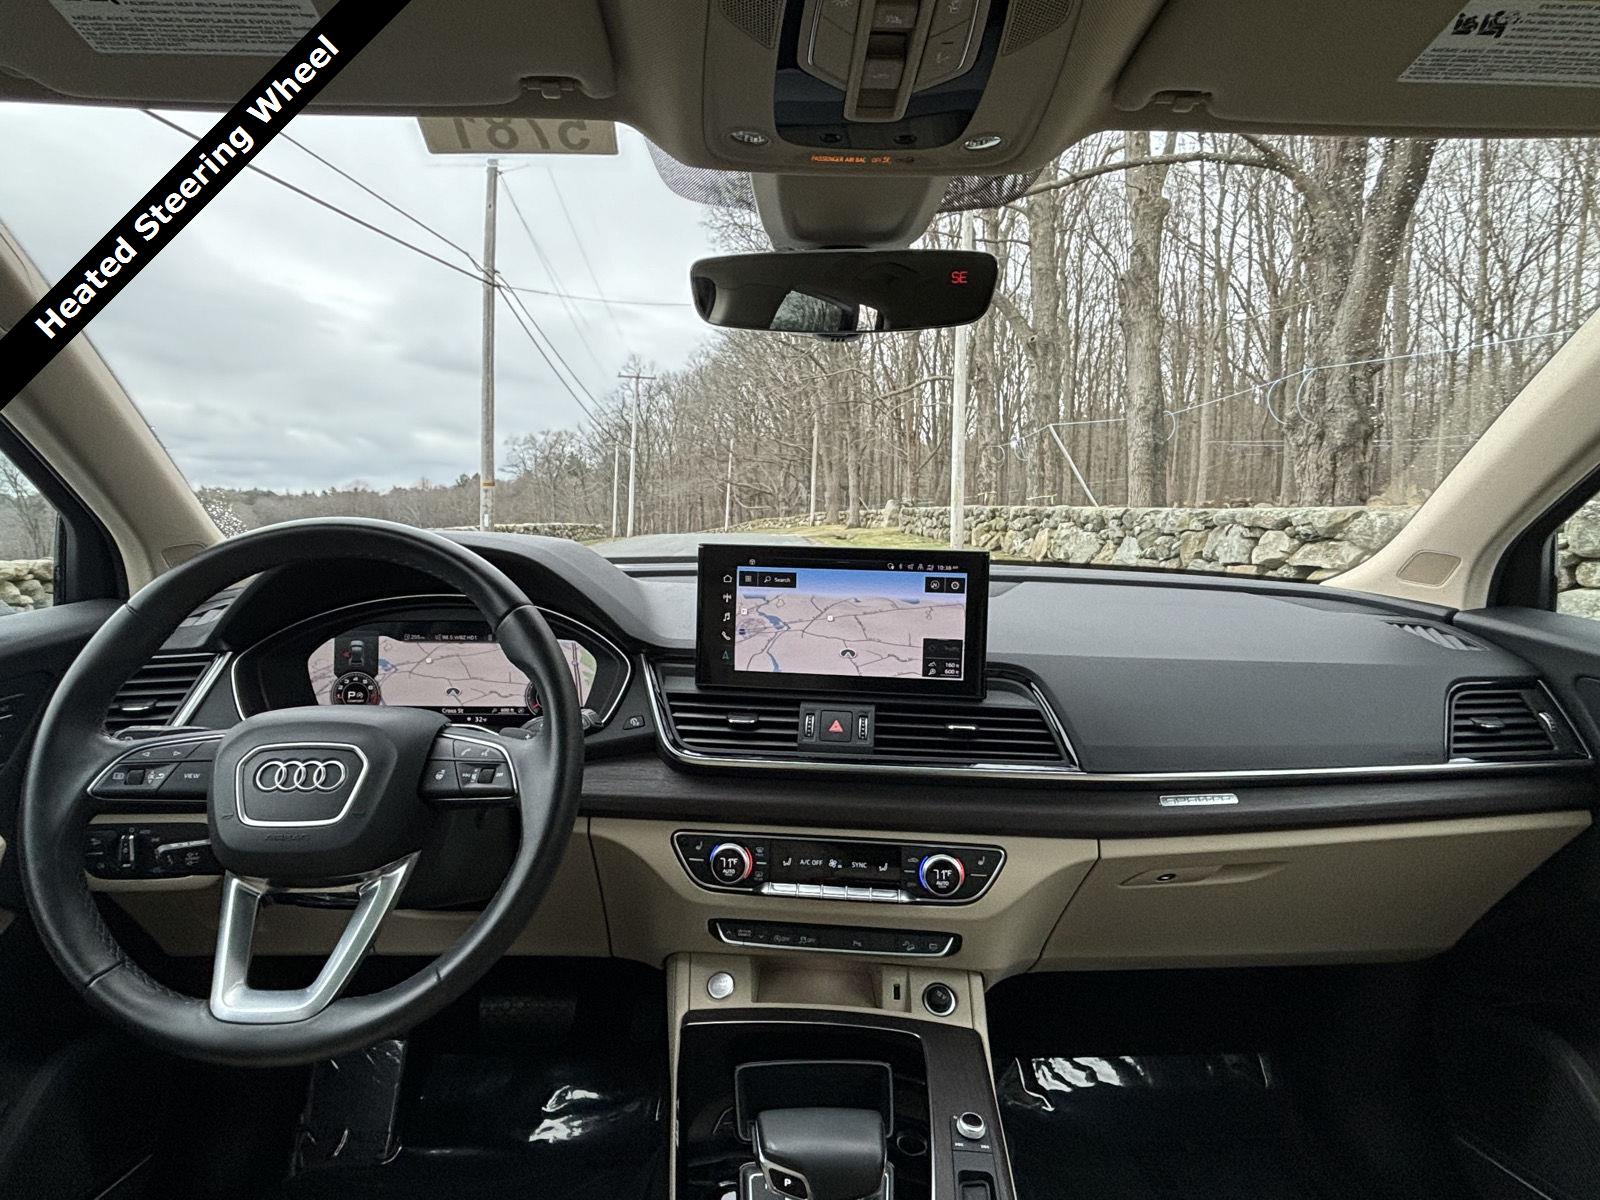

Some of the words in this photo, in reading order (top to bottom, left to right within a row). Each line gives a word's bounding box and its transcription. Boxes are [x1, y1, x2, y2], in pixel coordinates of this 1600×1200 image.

[951, 271, 968, 284] SE
[347, 691, 356, 700] P
[851, 861, 867, 869] SYNC
[784, 1178, 792, 1187] P
